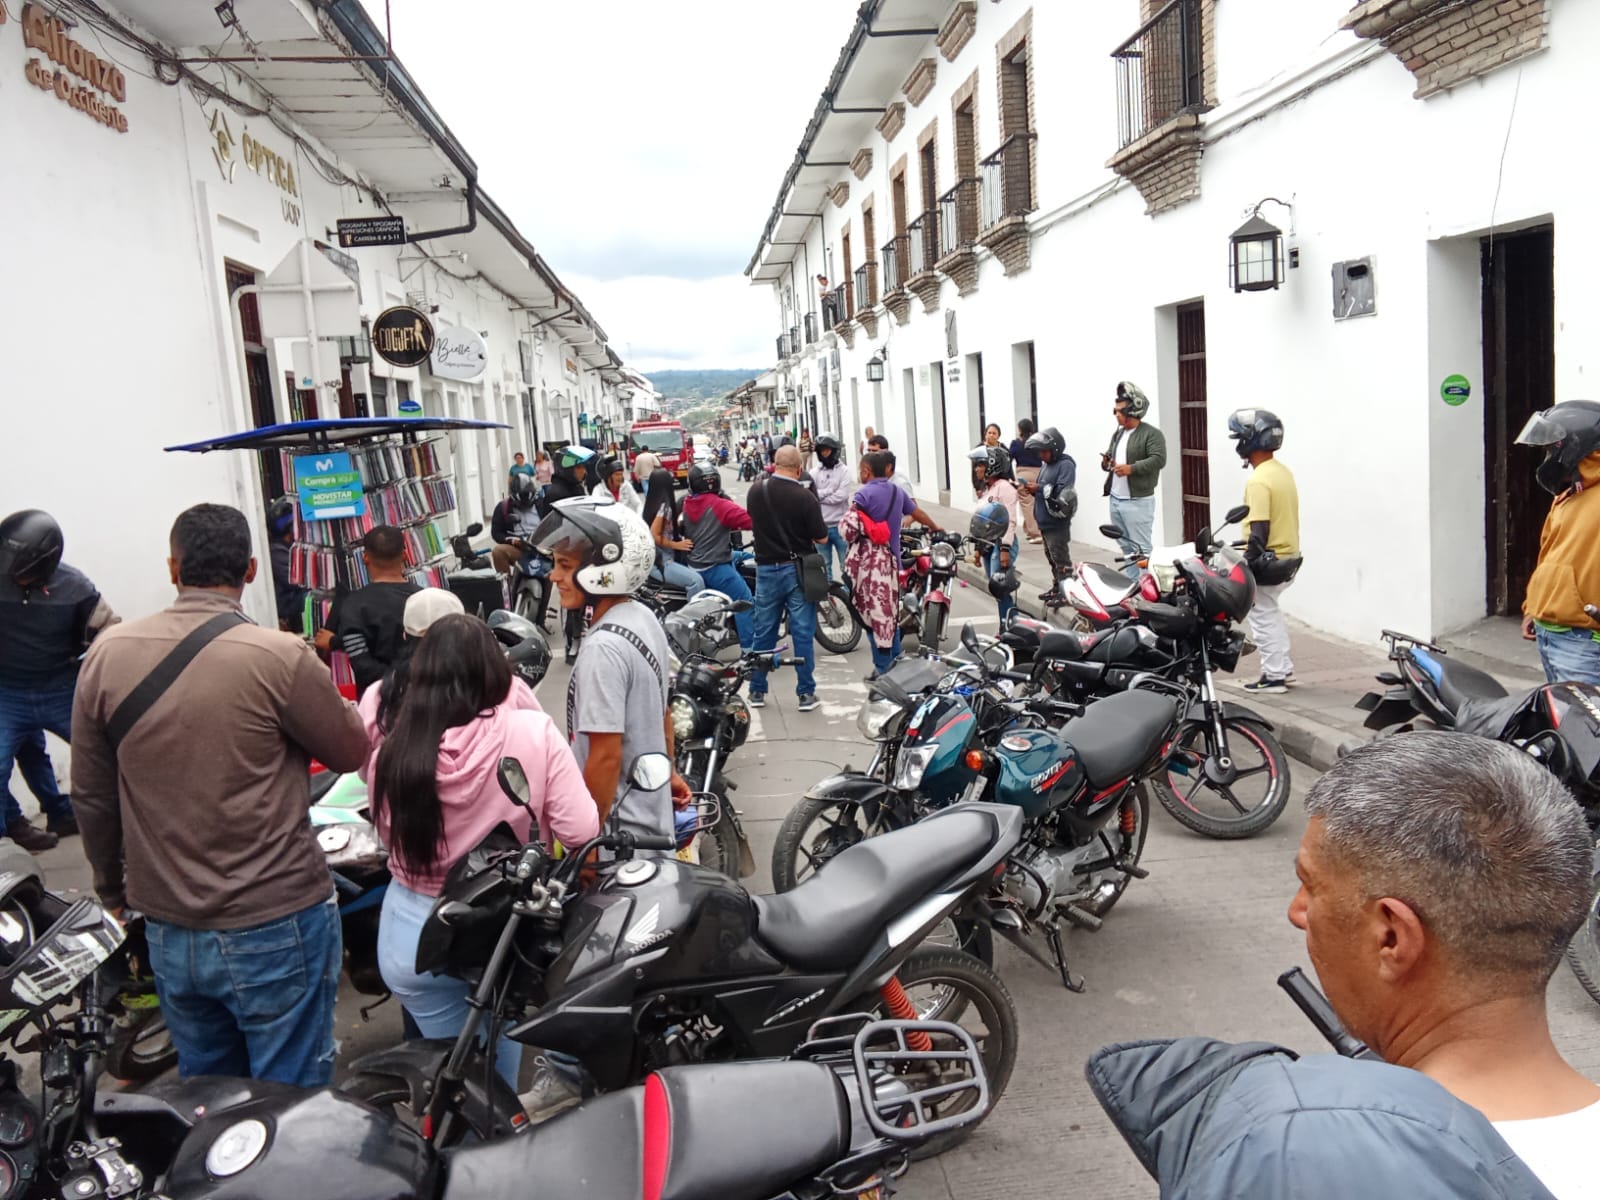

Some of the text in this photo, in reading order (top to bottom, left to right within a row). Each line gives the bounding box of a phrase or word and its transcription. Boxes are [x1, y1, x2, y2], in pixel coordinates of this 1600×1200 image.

[22, 3, 126, 103] Alianza
[25, 58, 128, 133] de Occidente
[242, 123, 298, 198] ÓPTICA
[304, 476, 337, 487] Compra
[313, 490, 352, 500] MOVISTAR
[629, 929, 674, 953] HONDA
